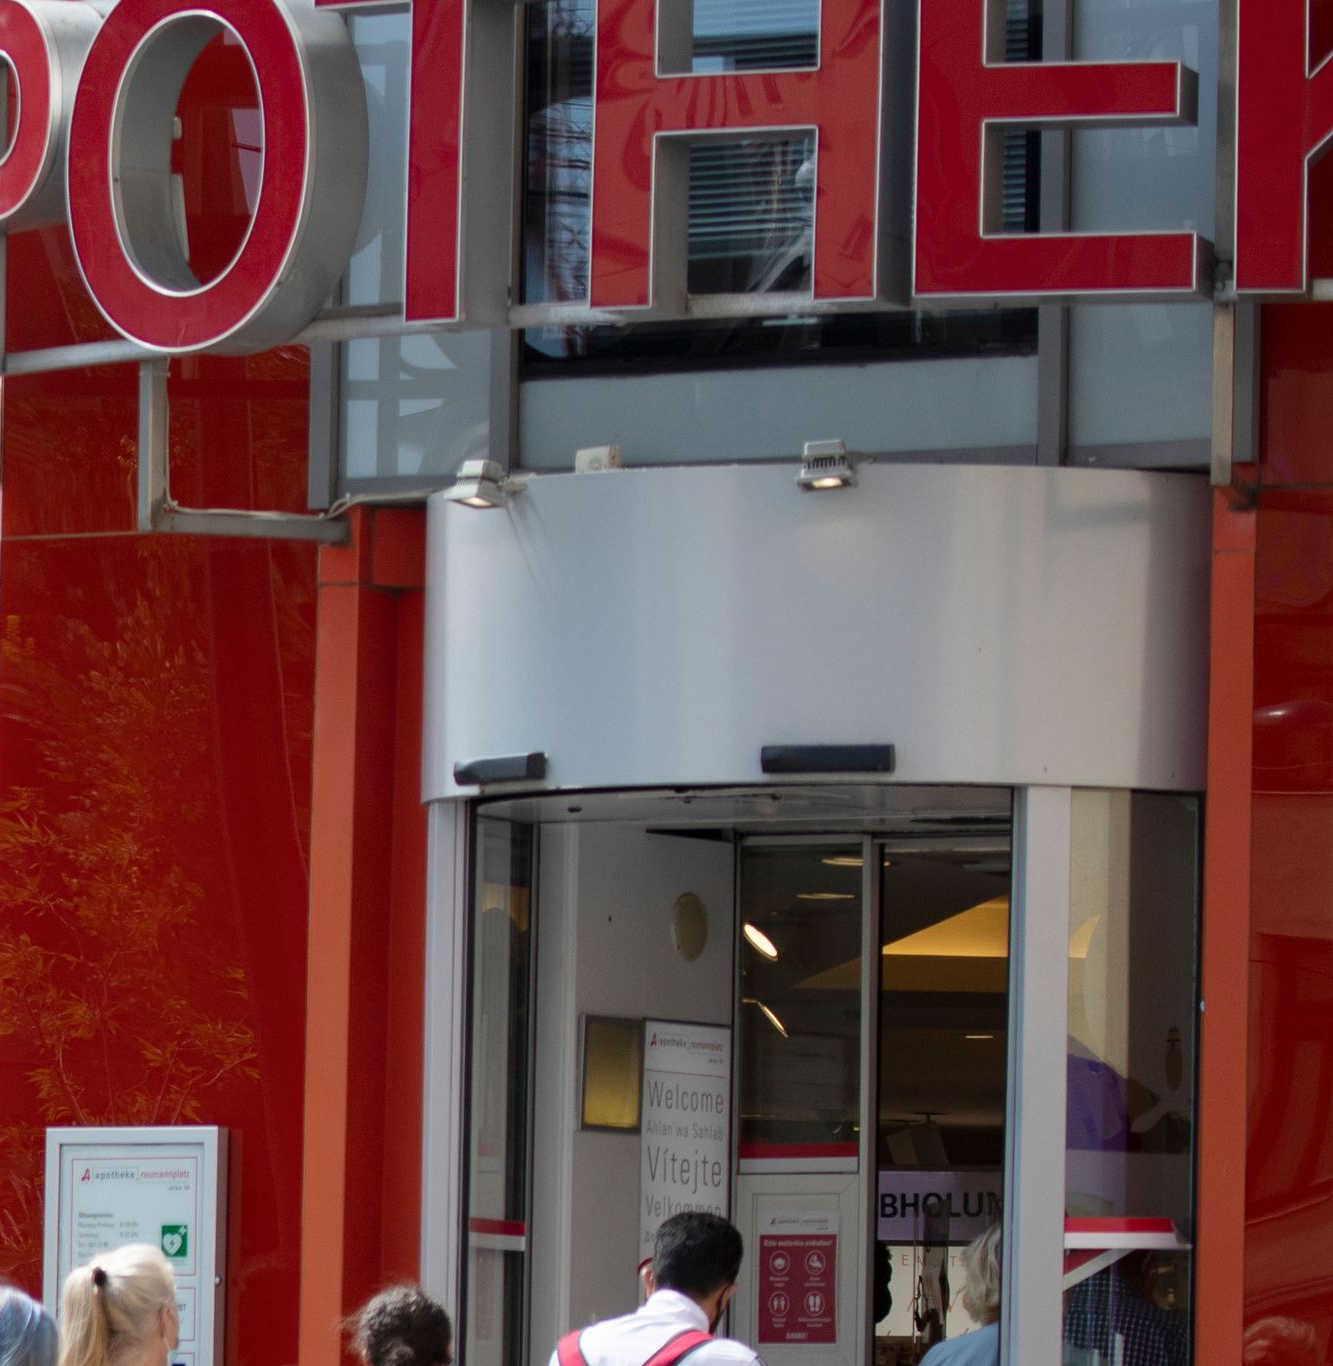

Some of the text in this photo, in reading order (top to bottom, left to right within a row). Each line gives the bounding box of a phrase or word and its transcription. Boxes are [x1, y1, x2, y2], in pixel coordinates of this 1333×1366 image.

[648, 1079, 724, 1114] Welcome
[95, 1169, 136, 1181] apotheke
[647, 1145, 722, 1195] Vítejte
